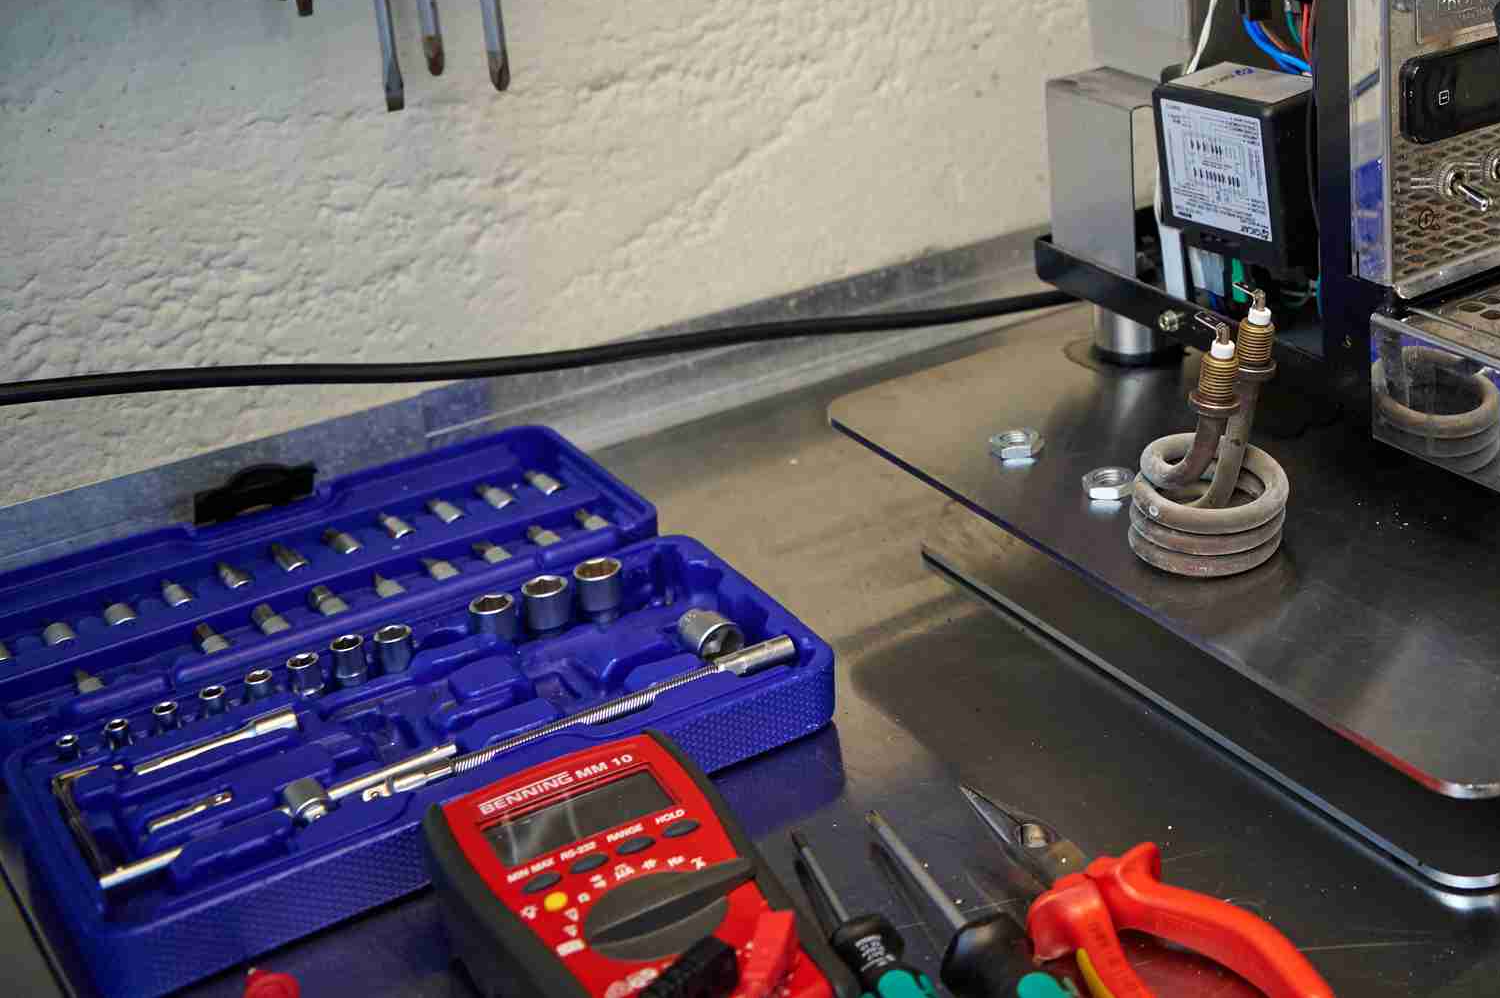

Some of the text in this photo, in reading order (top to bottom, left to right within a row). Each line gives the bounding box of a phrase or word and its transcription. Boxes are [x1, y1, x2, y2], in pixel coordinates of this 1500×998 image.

[479, 754, 633, 816] BENNING MM 10
[655, 809, 686, 825] HOLD
